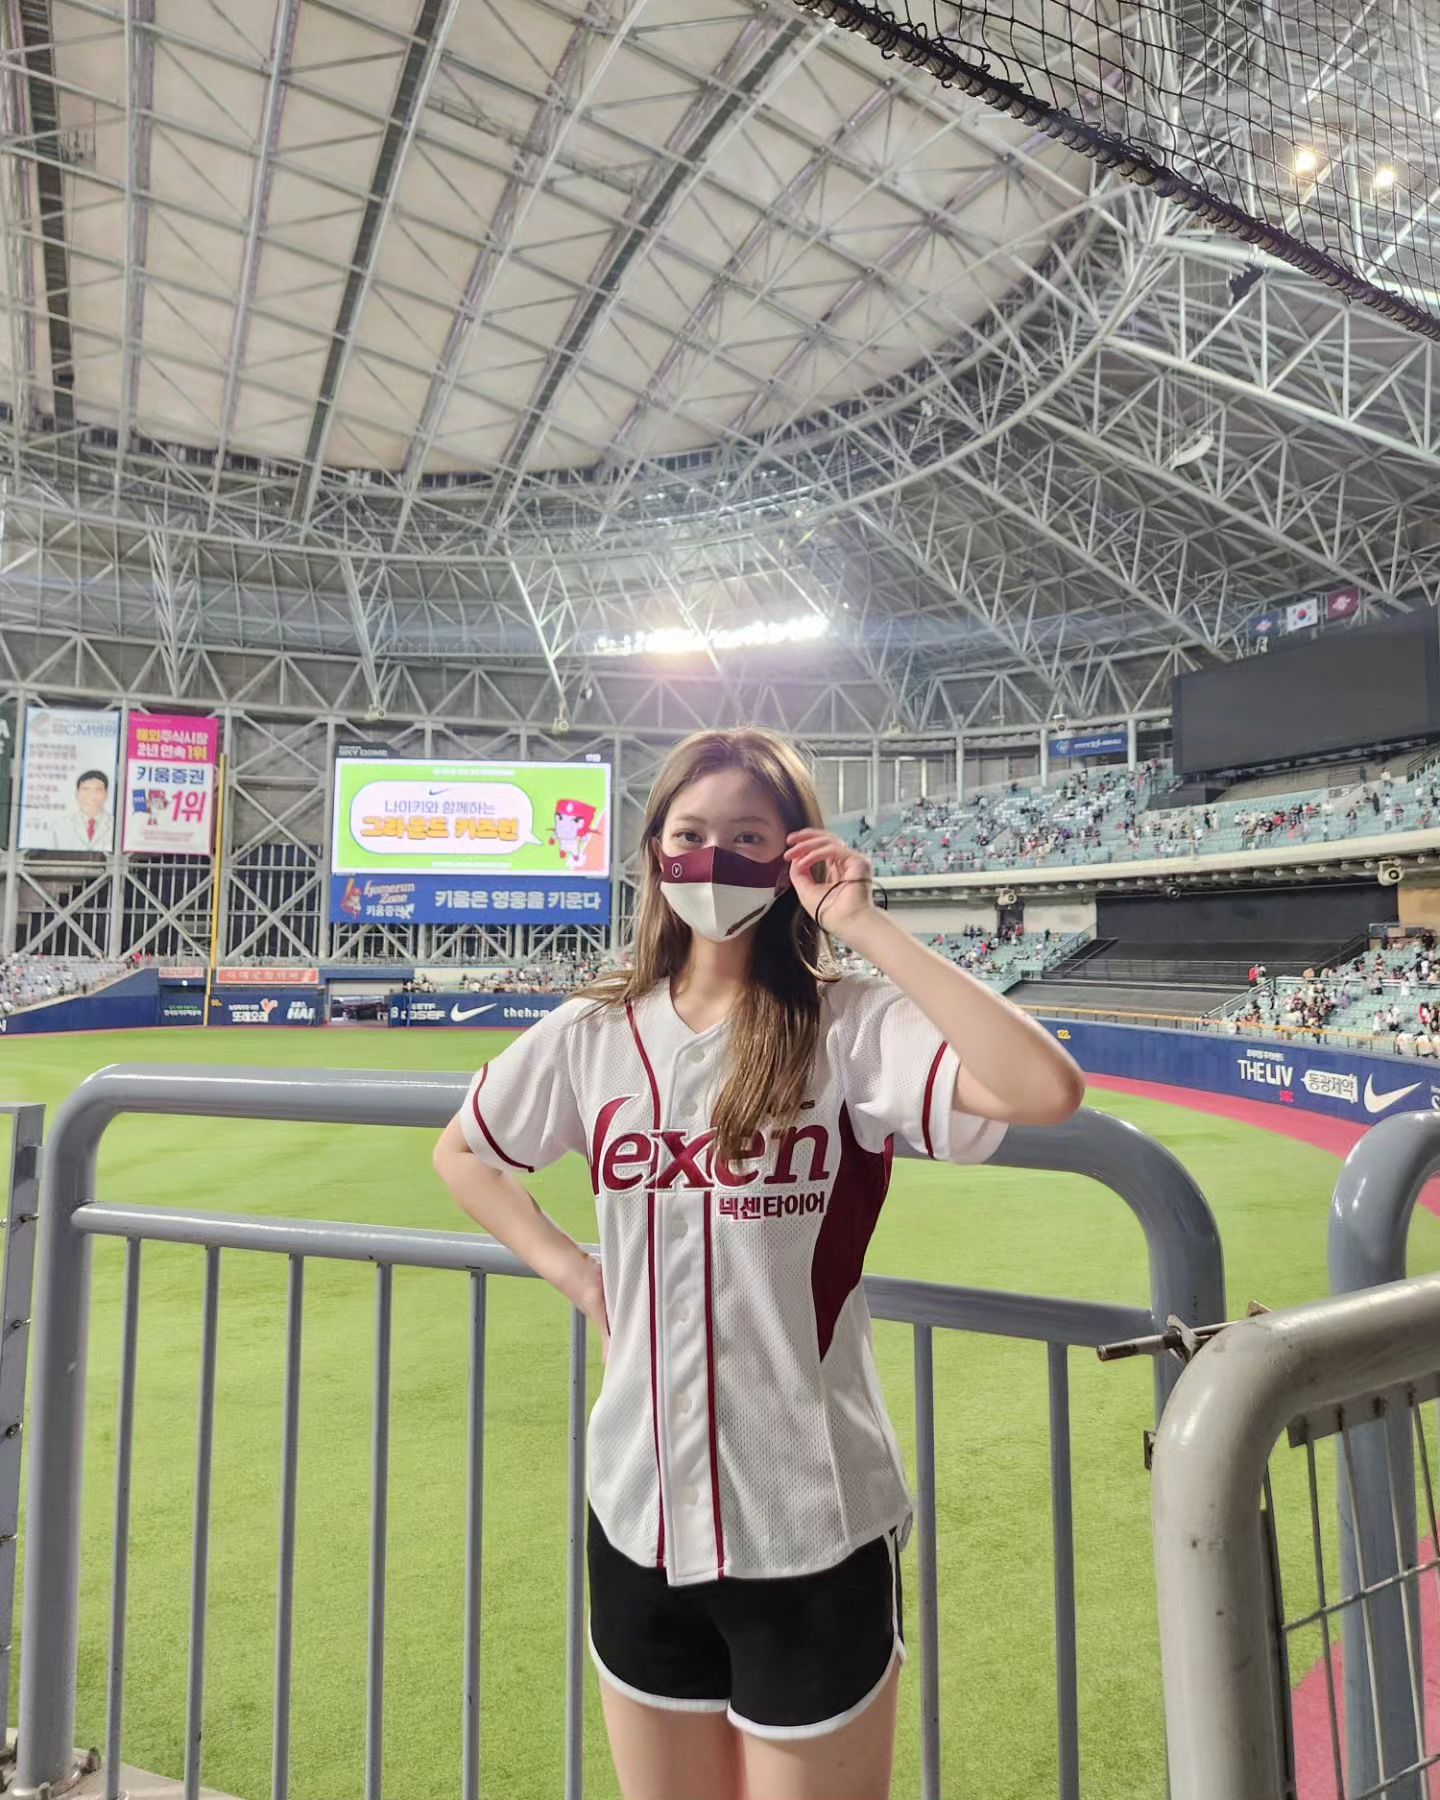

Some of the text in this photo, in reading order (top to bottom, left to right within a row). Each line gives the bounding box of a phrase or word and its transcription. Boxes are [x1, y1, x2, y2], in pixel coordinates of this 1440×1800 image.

[137, 766, 205, 785] 키움증권
[171, 790, 207, 823] 1위
[384, 800, 496, 815] 나이키와 함께하는
[360, 816, 449, 841] 그라운드
[435, 890, 602, 910] 키움은 영웅을 키운다
[1308, 1072, 1355, 1098] 동광제약
[719, 1192, 826, 1220] 넥센타이어
